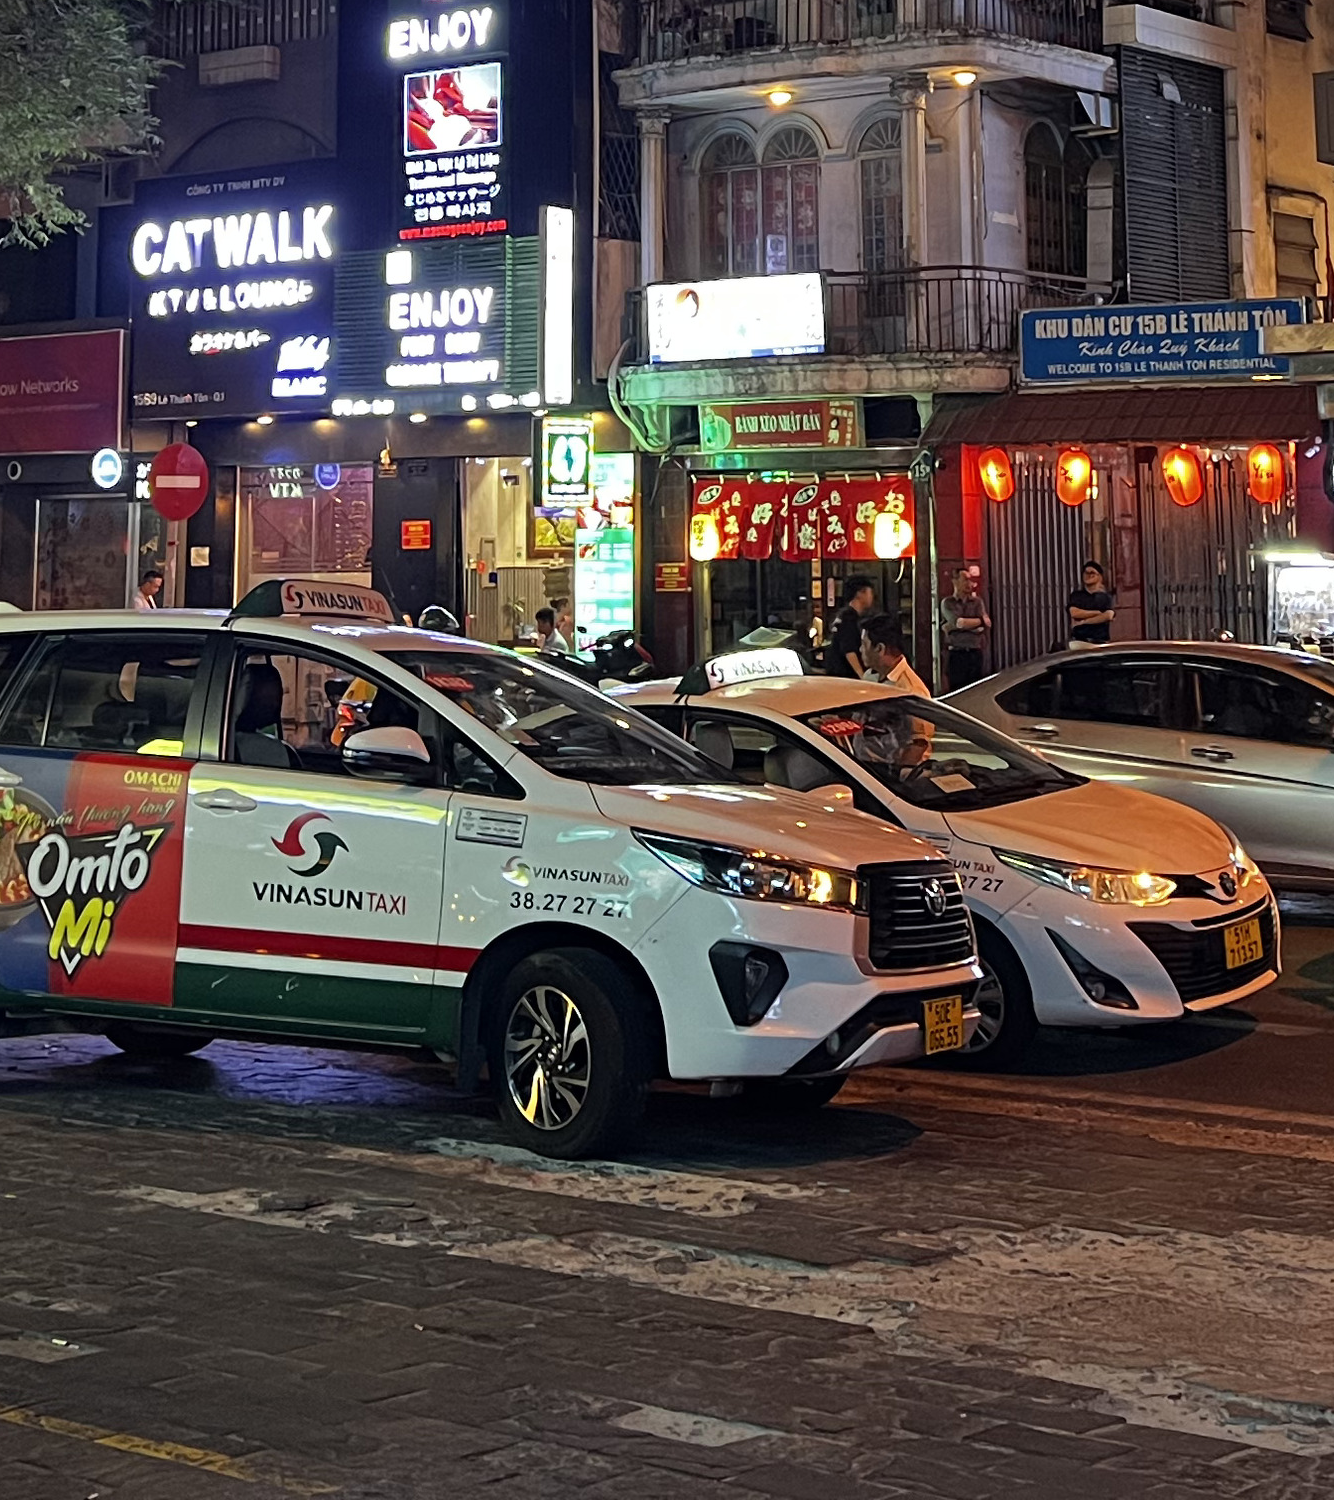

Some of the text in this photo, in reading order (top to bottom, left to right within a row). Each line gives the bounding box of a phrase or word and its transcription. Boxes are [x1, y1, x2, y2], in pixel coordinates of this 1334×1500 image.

[388, 8, 493, 59] ENJOY
[132, 204, 335, 276] CATWALK
[148, 287, 200, 317] KTV
[219, 278, 315, 312] LOUNGE
[388, 286, 495, 331] ENJOY
[1034, 317, 1068, 339] KHU
[1072, 314, 1105, 338] DÂN
[1108, 314, 1135, 337] CƯ
[1137, 314, 1168, 336] 15B
[1170, 309, 1188, 334] LÊ
[1190, 307, 1249, 334] THÁNH
[1047, 361, 1097, 376] WELCOME
[1098, 361, 1113, 374] TO
[1133, 360, 1147, 373] LE
[1148, 359, 1184, 373] THANH
[1185, 359, 1208, 372] TON
[1208, 356, 1277, 371] RESIDENTIAL
[20, 376, 80, 395] Networks
[735, 413, 759, 434] BÁNH
[123, 769, 183, 787] OMACHI
[972, 861, 995, 875] TAXI
[981, 877, 1004, 893] 27
[509, 890, 631, 919] 38.27 27 27
